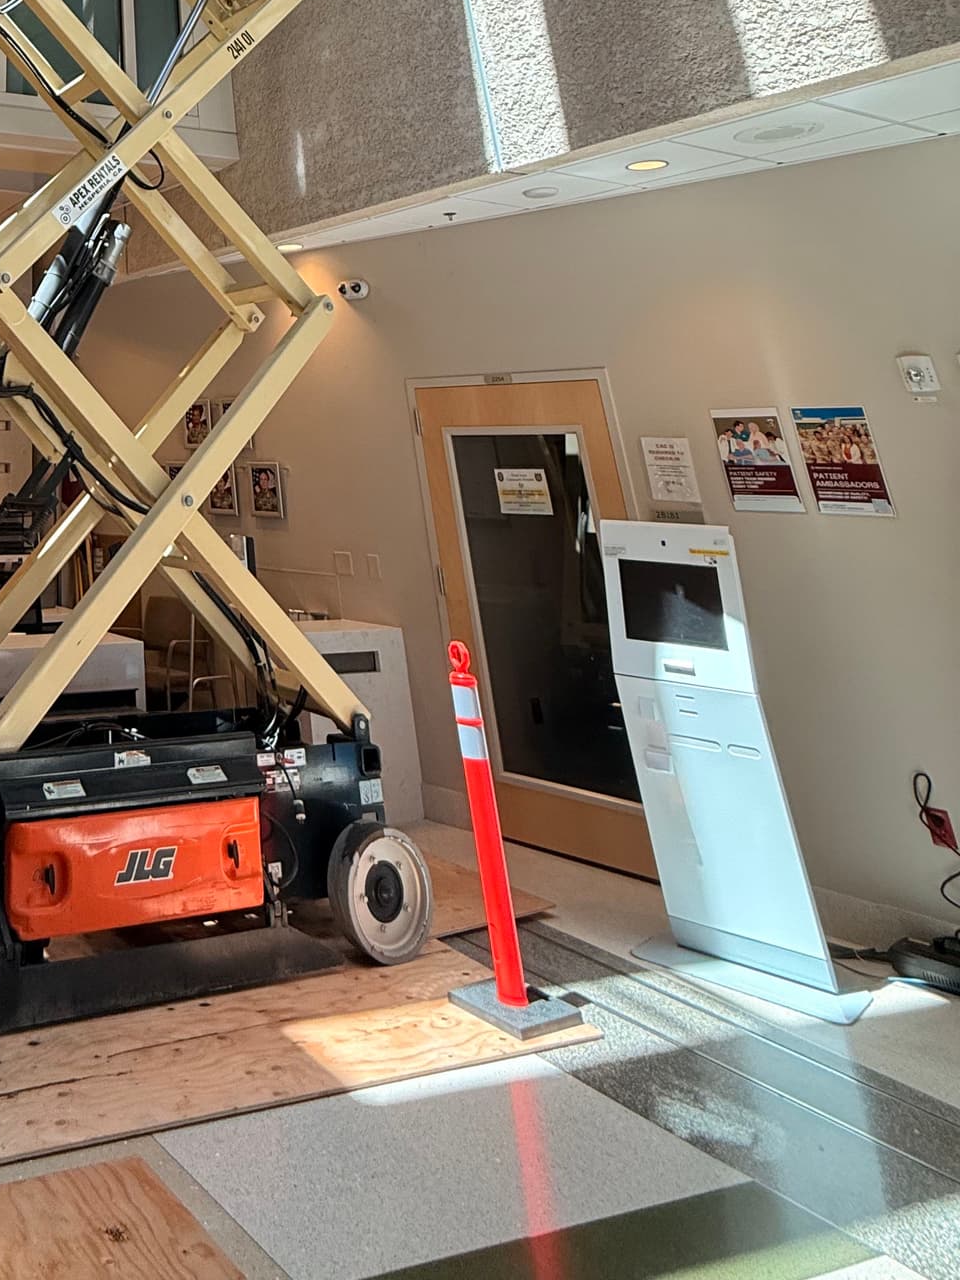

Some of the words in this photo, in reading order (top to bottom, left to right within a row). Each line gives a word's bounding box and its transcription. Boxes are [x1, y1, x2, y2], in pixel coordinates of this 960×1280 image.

[112, 167, 123, 177] CA
[69, 183, 91, 208] APEX
[87, 155, 121, 189] RENTALS
[813, 472, 848, 480] PATIENT
[816, 480, 880, 489] AMBASSADORS
[114, 846, 177, 885] JLG
